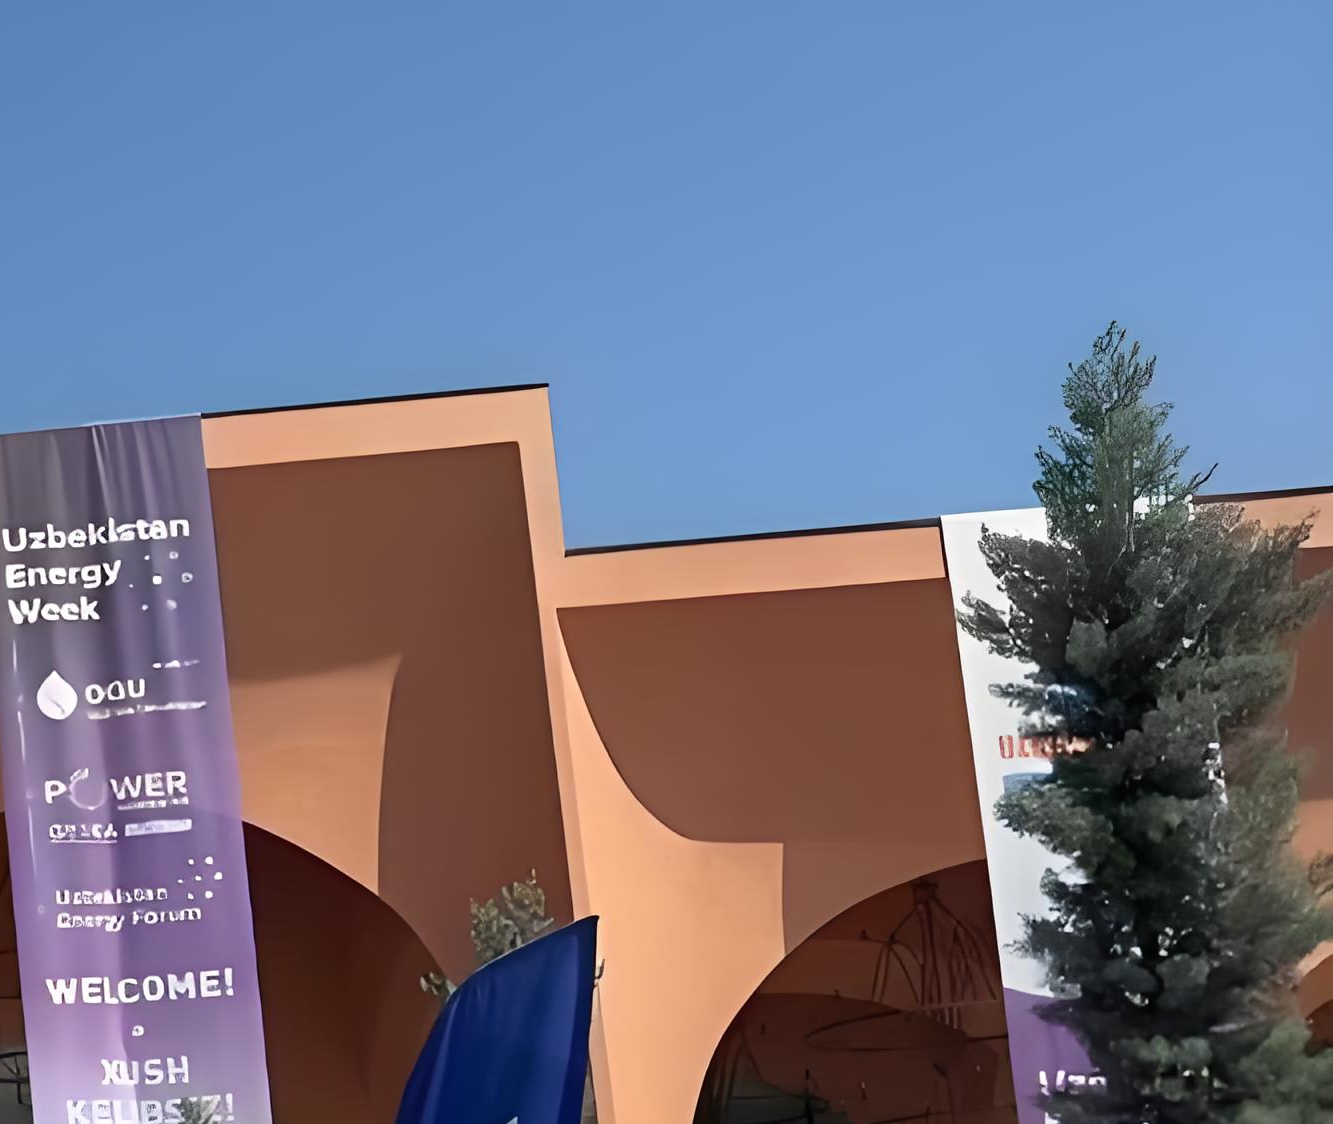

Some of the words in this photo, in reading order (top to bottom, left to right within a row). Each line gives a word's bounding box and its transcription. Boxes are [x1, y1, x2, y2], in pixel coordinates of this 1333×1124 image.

[2, 517, 190, 552] Uzbekistan
[5, 560, 121, 589] Energy
[7, 596, 100, 625] Week
[45, 967, 234, 1005] WELCOME!
[101, 1055, 190, 1086] XUSH
